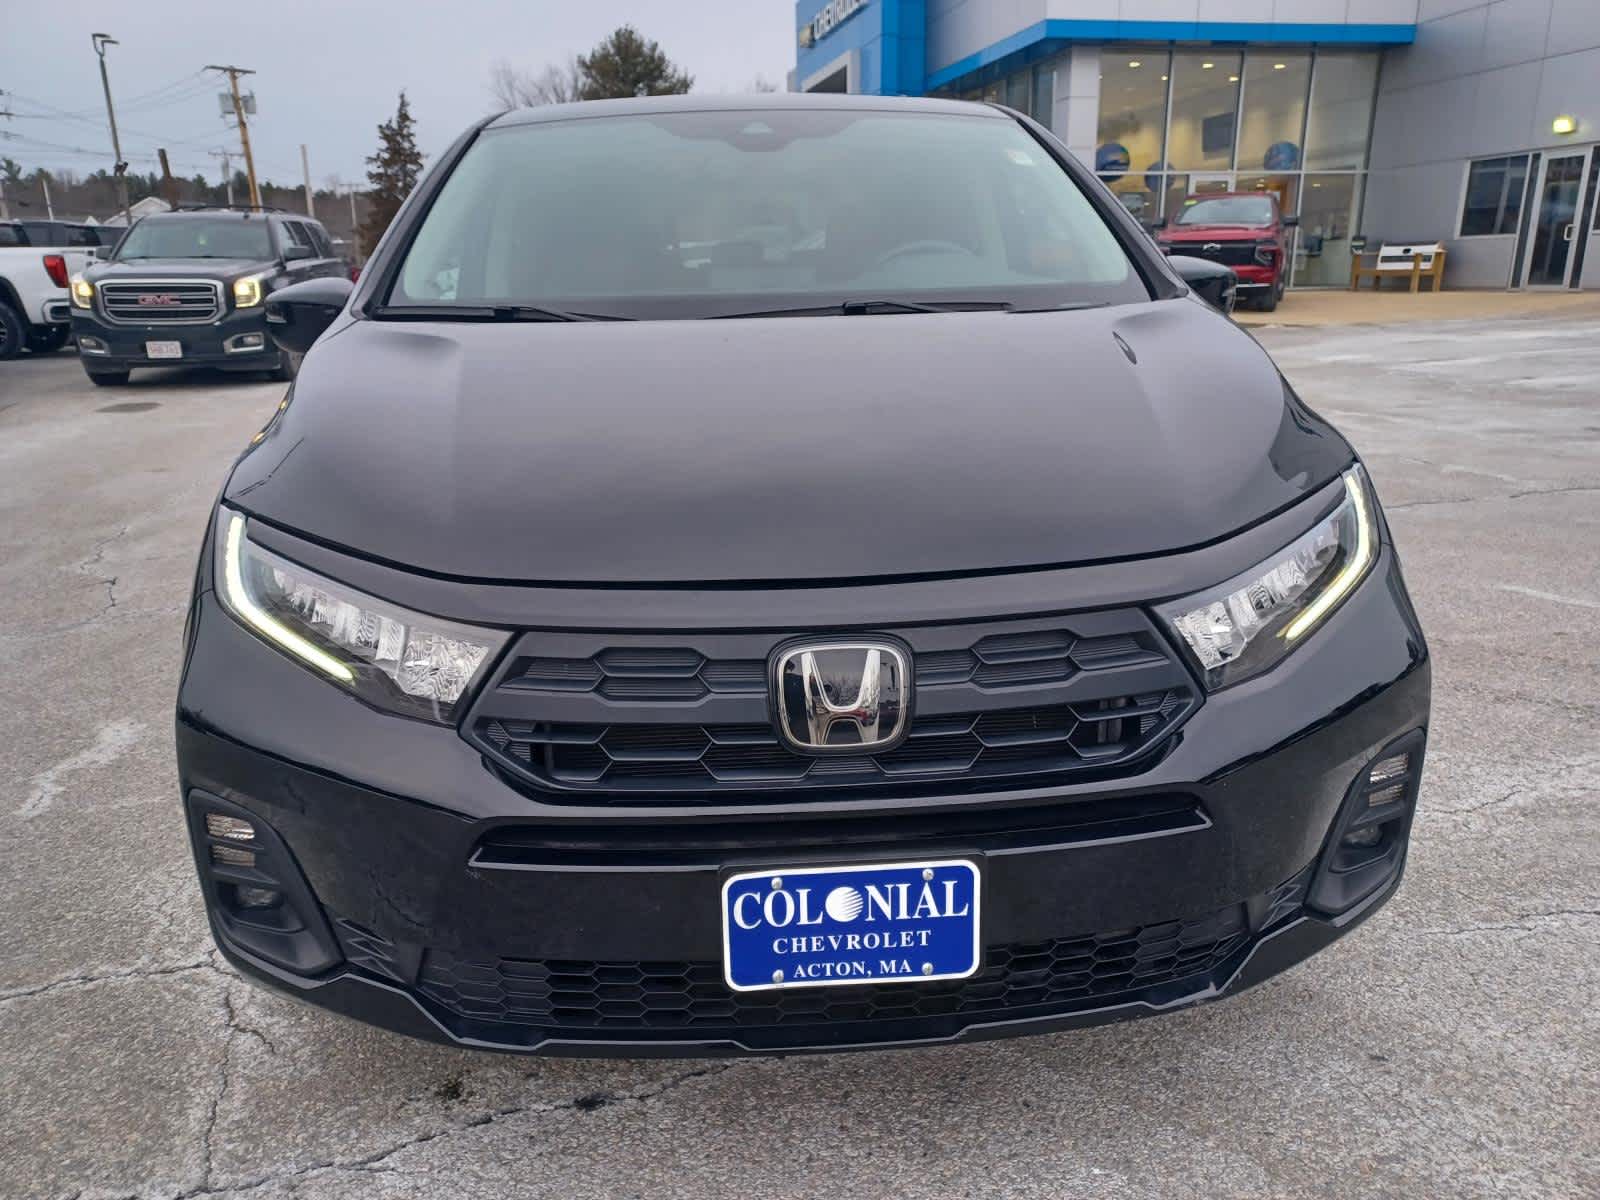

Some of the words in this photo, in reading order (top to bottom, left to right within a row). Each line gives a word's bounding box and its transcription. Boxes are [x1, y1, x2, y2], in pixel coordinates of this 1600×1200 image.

[137, 294, 181, 305] GMC
[773, 930, 932, 954] CHEVROLET
[793, 961, 872, 978] ACTON,
[880, 959, 912, 974] MA
